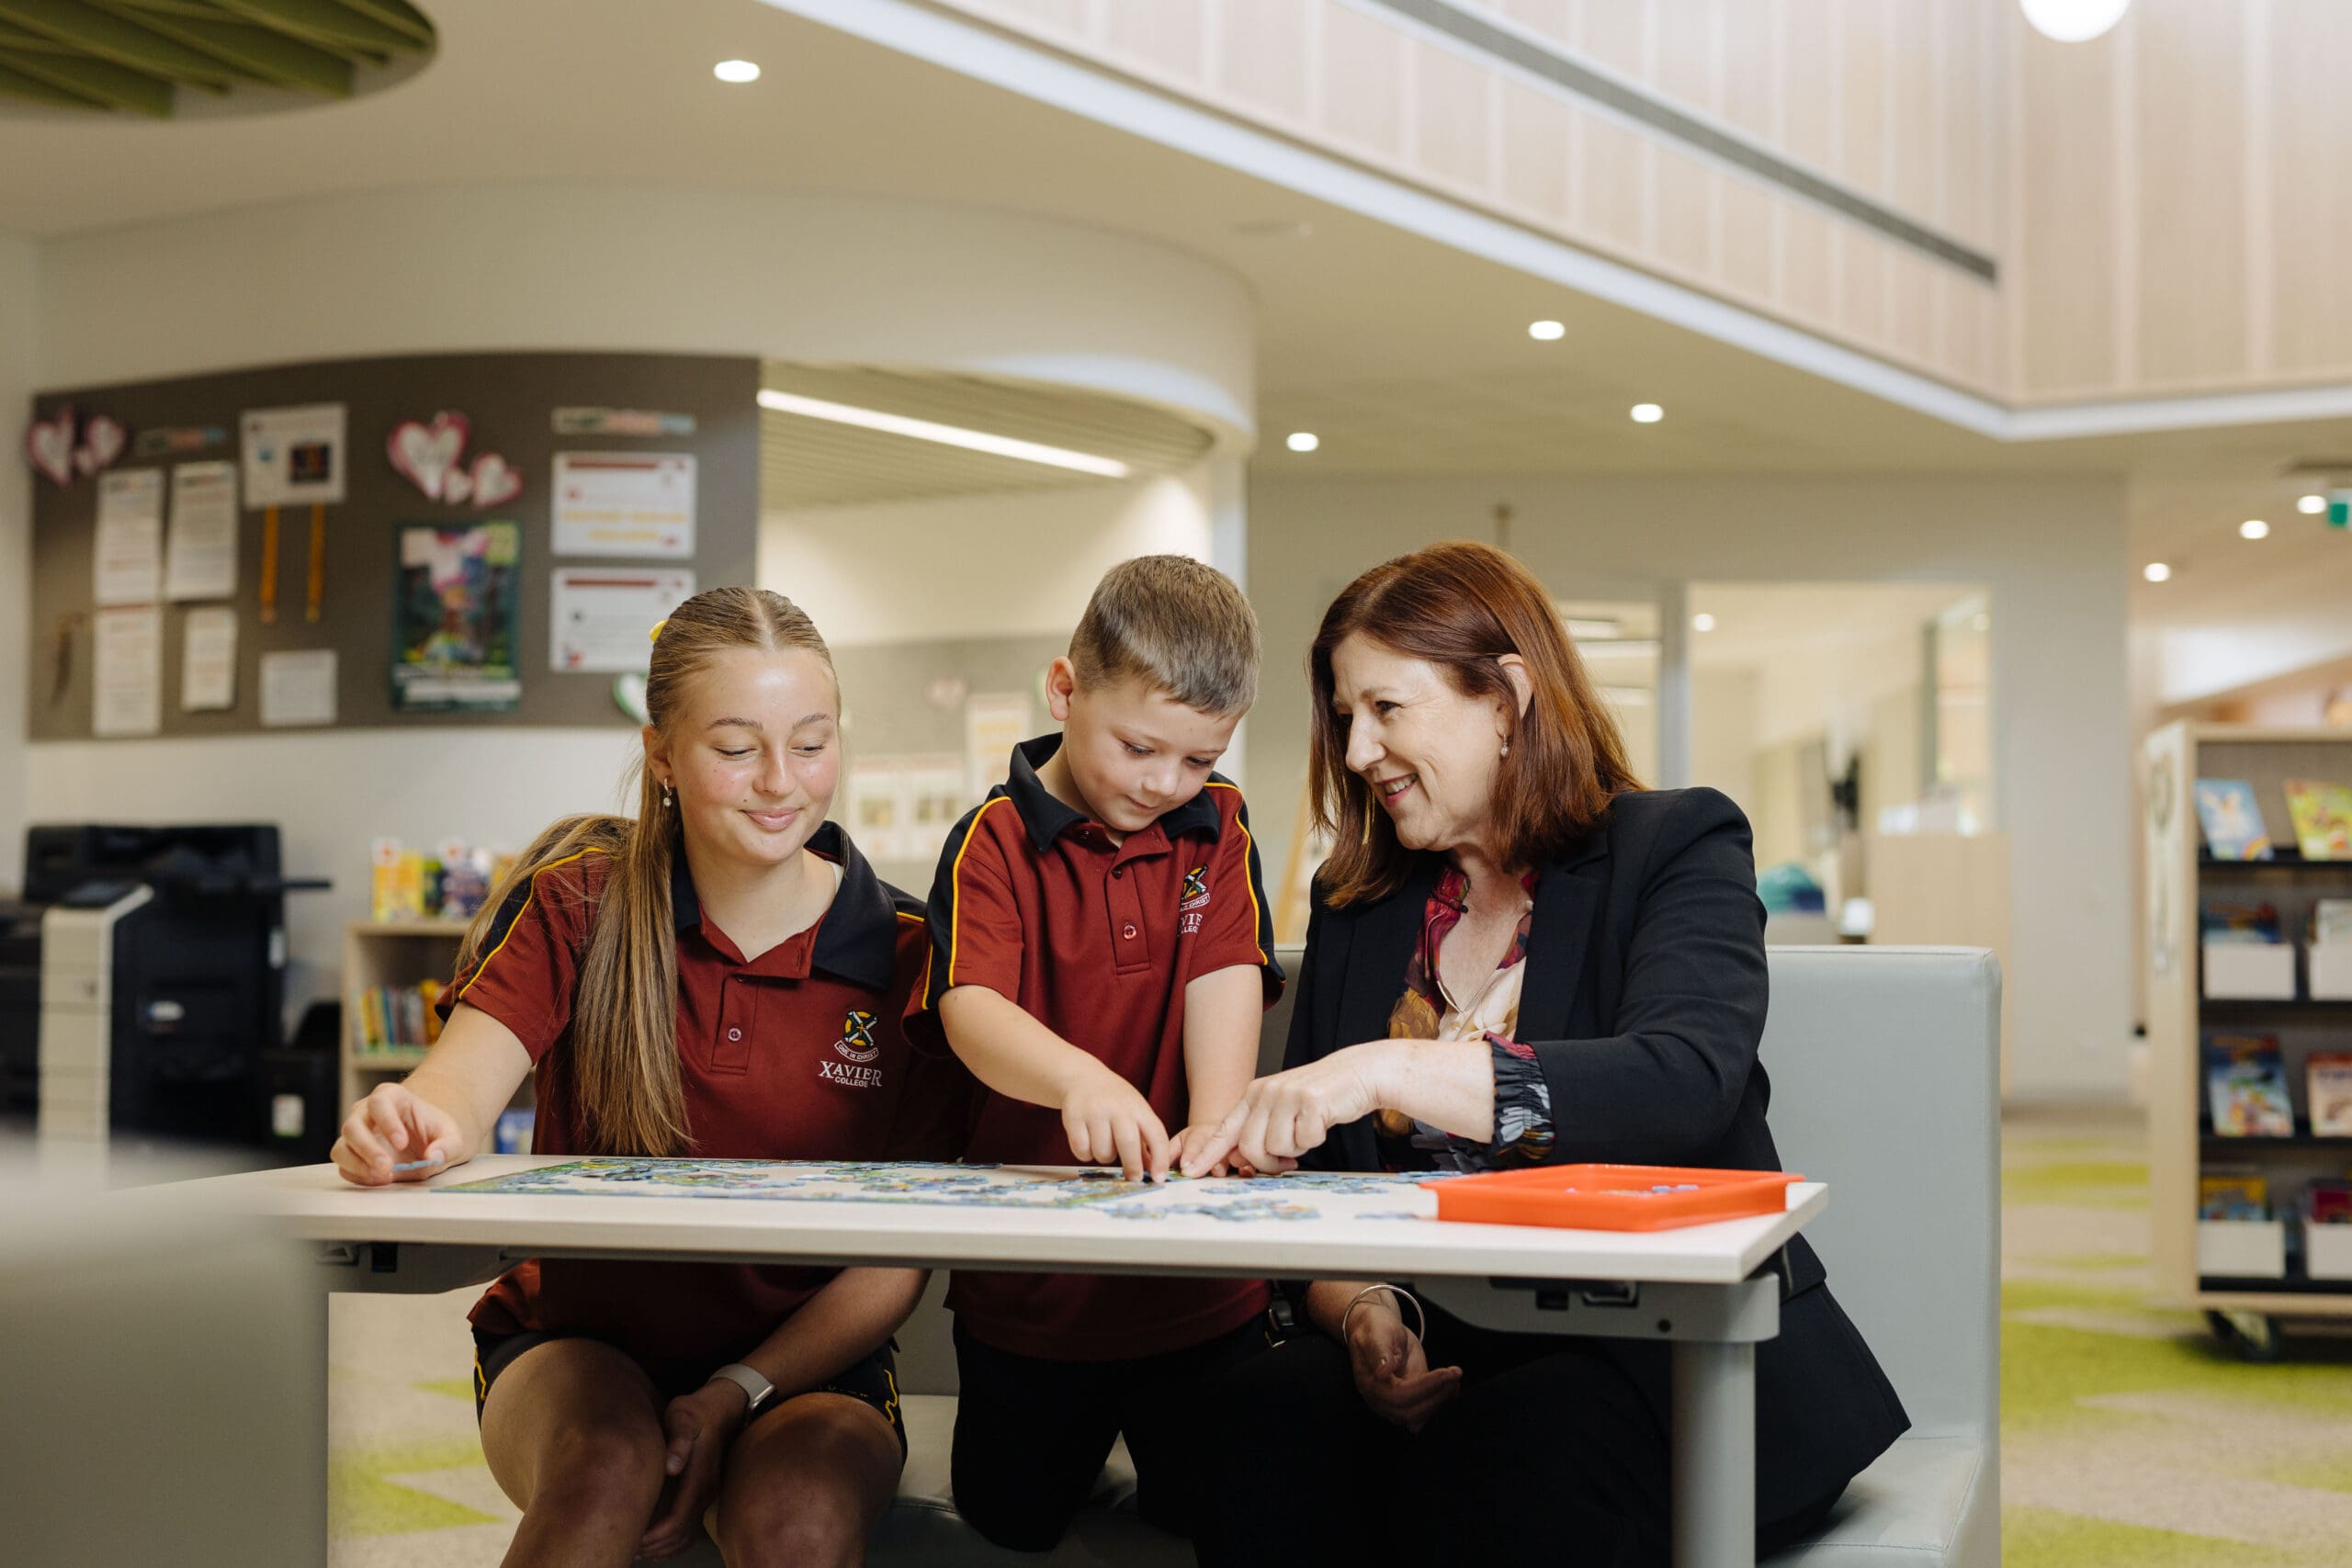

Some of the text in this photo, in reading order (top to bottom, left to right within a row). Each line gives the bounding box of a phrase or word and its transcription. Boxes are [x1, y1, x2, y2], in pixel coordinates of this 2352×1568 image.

[838, 1043, 848, 1055] ONE
[856, 1050, 876, 1059] CHRIST
[818, 1060, 883, 1088] XAVIER
[834, 1077, 868, 1088] COLLEGE
